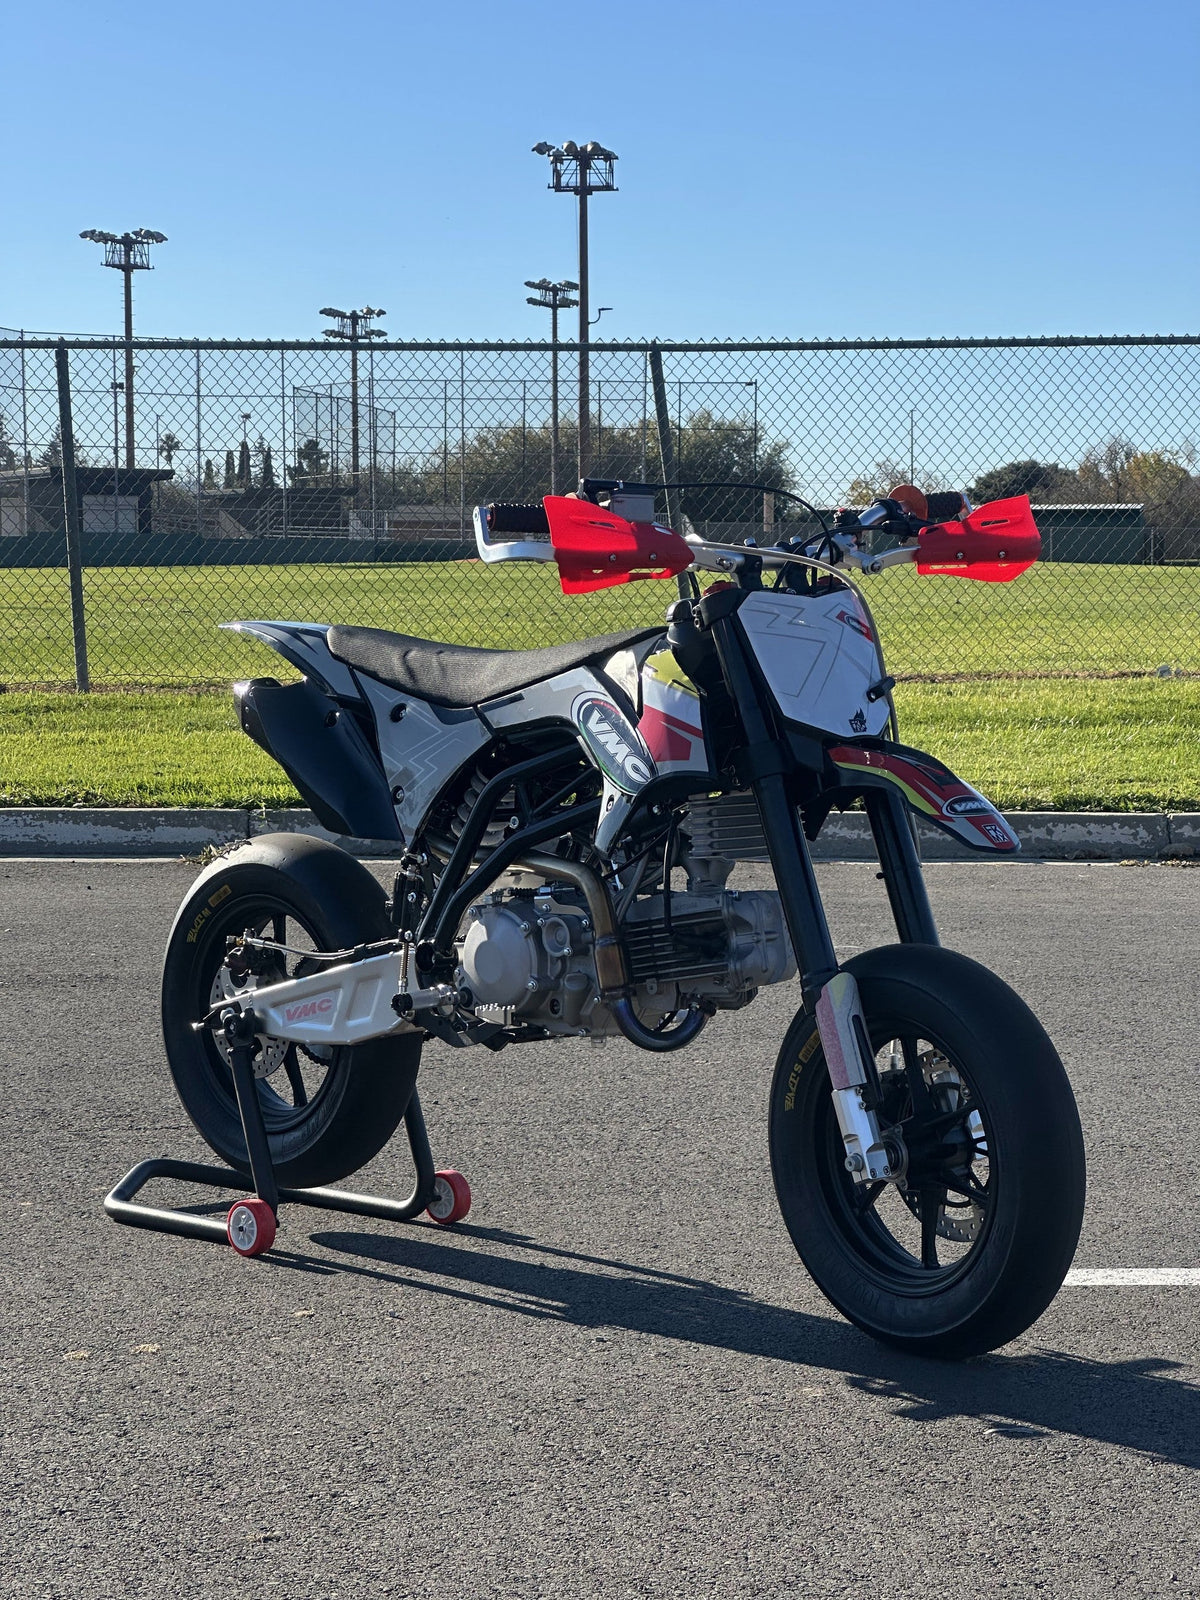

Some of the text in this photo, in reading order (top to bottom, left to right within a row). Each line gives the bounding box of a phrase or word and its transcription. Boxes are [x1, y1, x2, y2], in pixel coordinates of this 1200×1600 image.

[585, 706, 651, 784] VMC
[285, 998, 333, 1021] VMC
[793, 1063, 803, 1074] S
